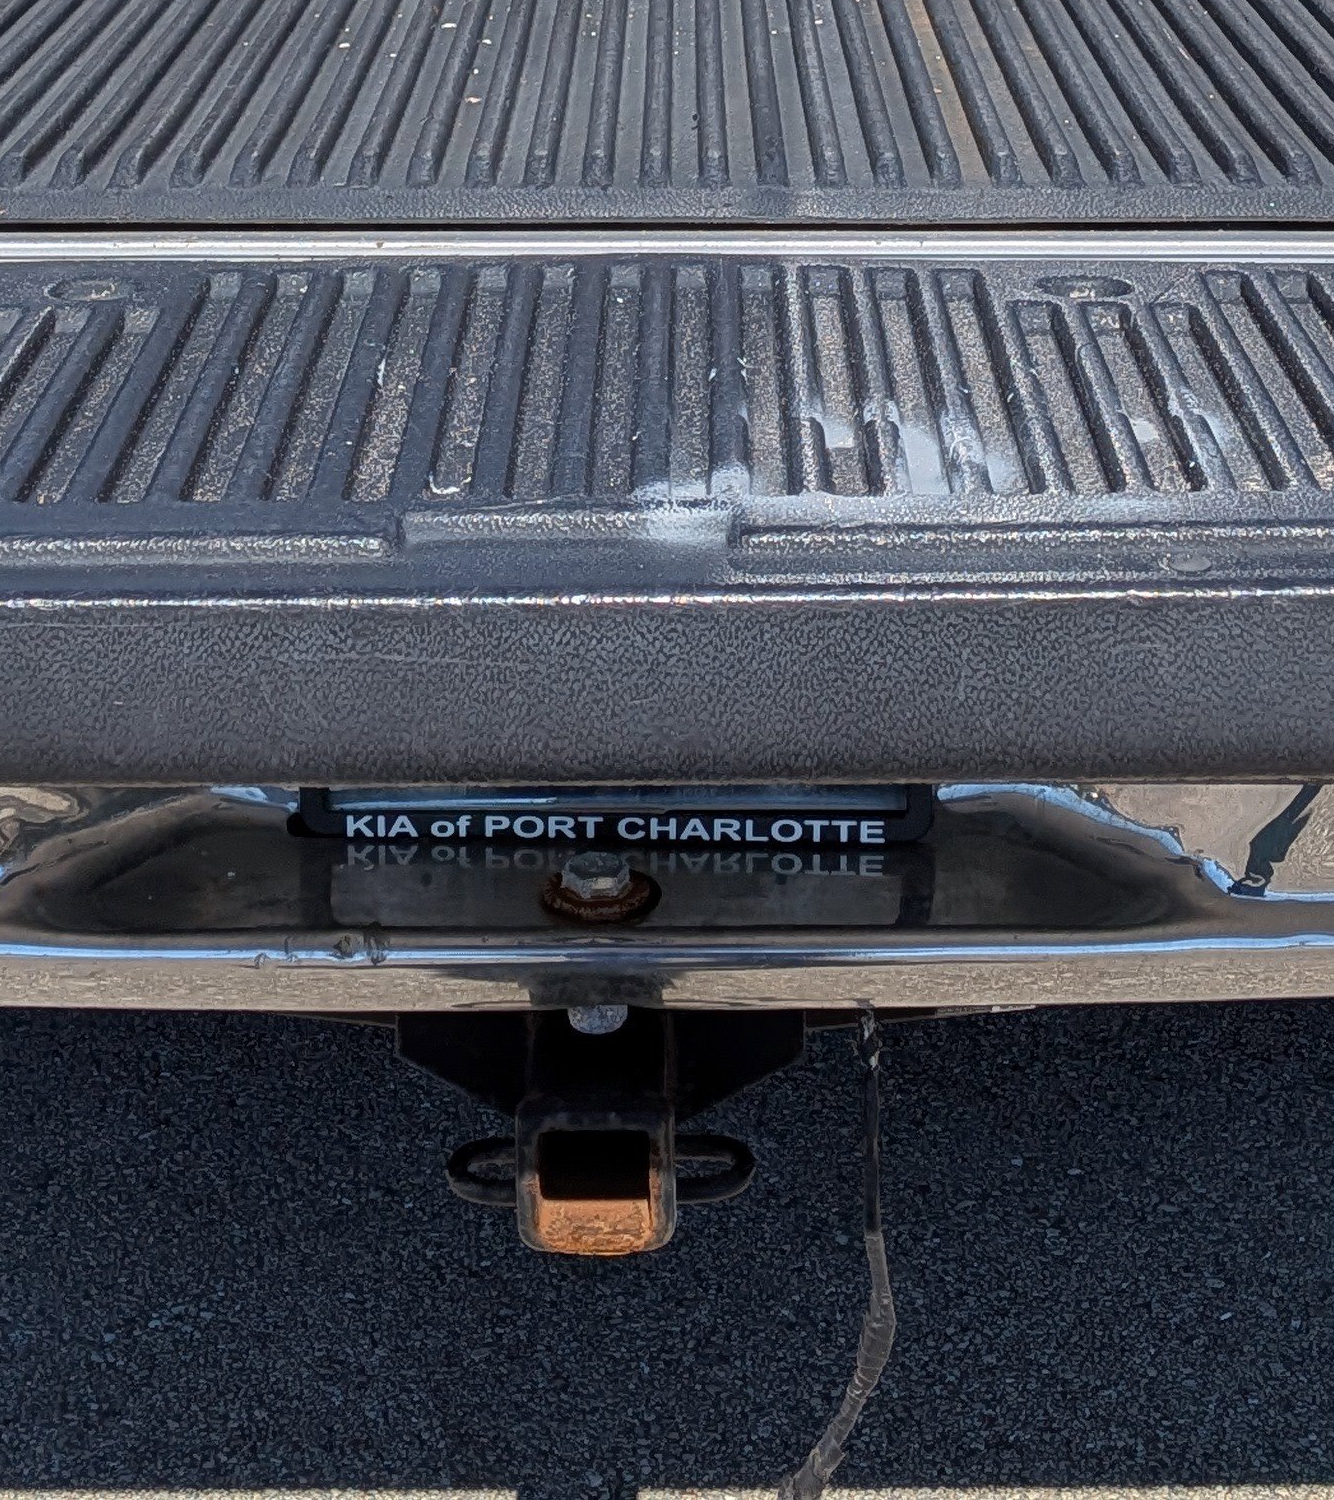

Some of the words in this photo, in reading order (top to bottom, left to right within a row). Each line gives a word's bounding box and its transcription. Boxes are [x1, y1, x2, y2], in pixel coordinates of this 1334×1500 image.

[346, 815, 418, 838] KIA
[430, 815, 471, 838] of
[484, 816, 604, 839] PORT
[617, 817, 885, 844] CHARLOTTE
